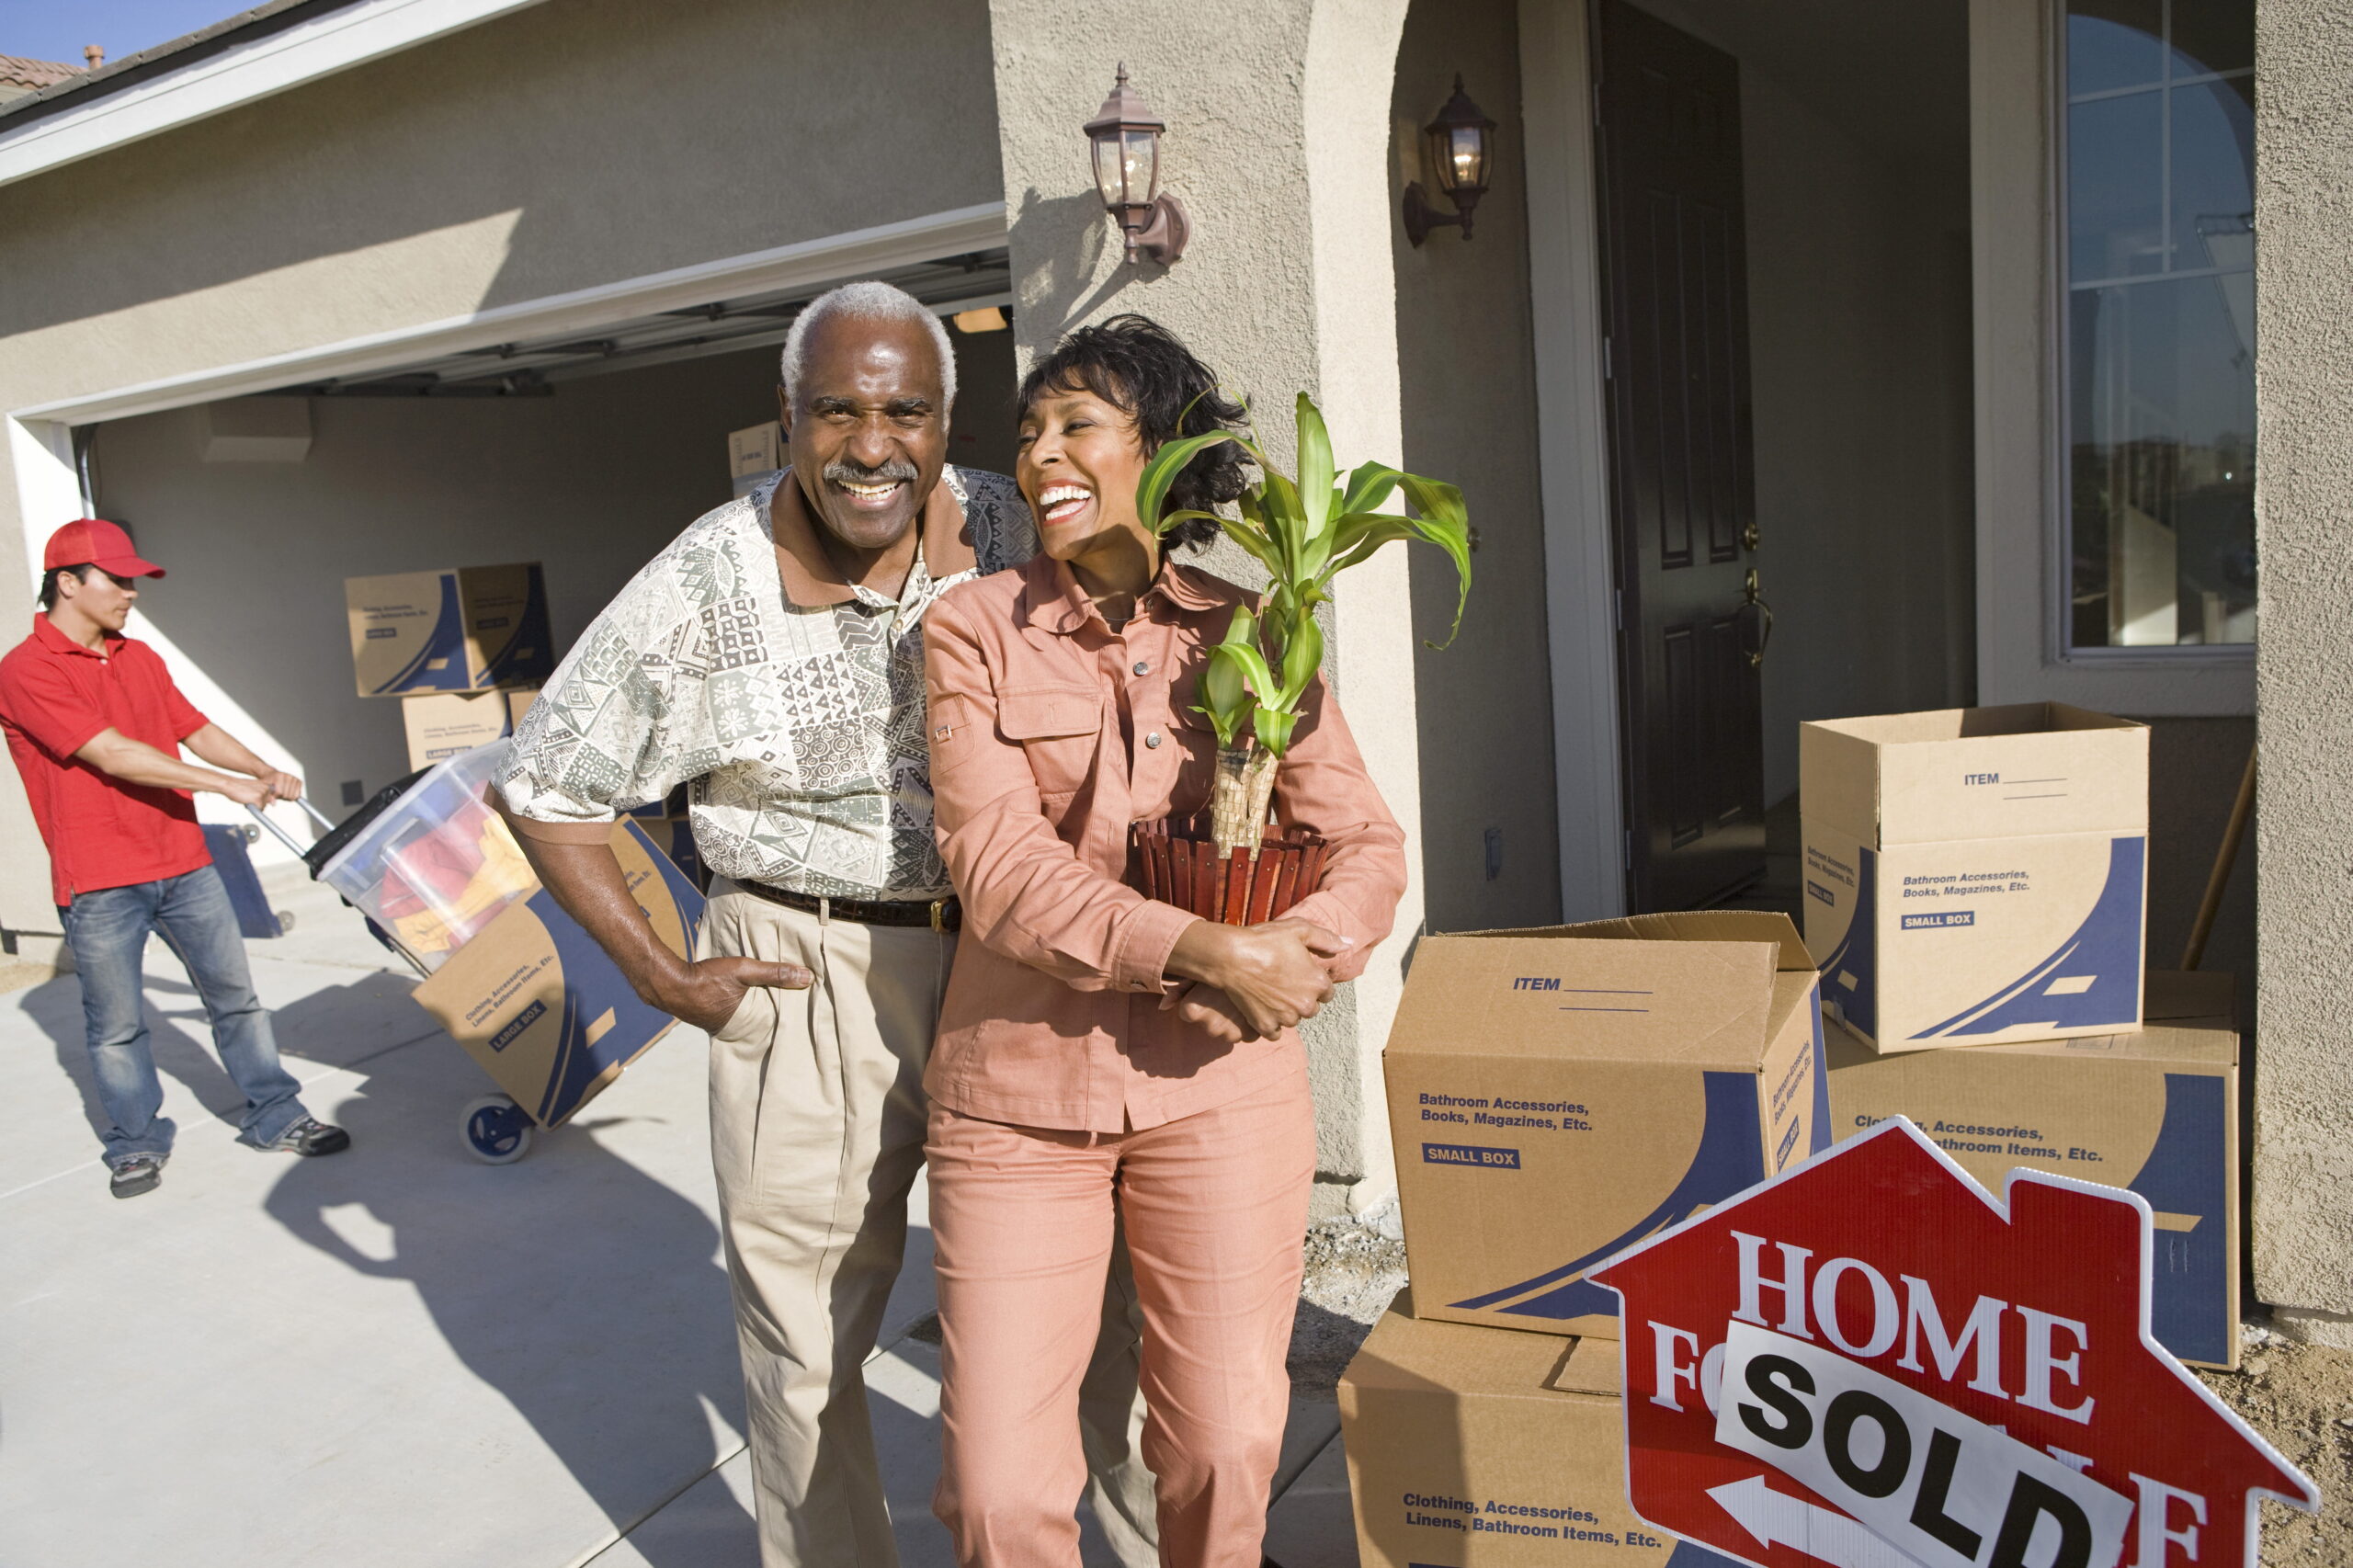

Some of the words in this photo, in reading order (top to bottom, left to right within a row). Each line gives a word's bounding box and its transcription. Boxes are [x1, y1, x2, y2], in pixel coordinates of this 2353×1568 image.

[1964, 773, 1999, 786] ITEM
[1904, 875, 1956, 885] Bathroom
[1960, 870, 2029, 882] Accessories,
[1904, 888, 1939, 897] Books,
[1944, 884, 2005, 896] Magazines,
[2009, 882, 2029, 892] Etc.
[1904, 916, 1943, 927] SMALL
[1946, 915, 1971, 925] BOX
[494, 982, 522, 1008] Bathroom
[1513, 977, 1561, 991] ITEM
[493, 1021, 523, 1048] LARGE
[520, 1006, 540, 1024] BOX
[1419, 1093, 1488, 1108] Bathroom
[1493, 1097, 1589, 1116] Accessories,
[1421, 1109, 1469, 1125] Books,
[1474, 1112, 1557, 1131] Magazines,
[1563, 1118, 1593, 1131] Etc.
[1933, 1120, 2043, 1142] Accessories,
[1428, 1148, 1478, 1163] SMALL
[1482, 1152, 1515, 1165] BOX
[2007, 1142, 2062, 1160] Items,
[2068, 1147, 2103, 1162] Etc.
[1731, 1230, 2095, 1425] HOME
[1737, 1354, 2092, 1568] SOLD
[1403, 1493, 1480, 1515] Clothing,
[1484, 1500, 1599, 1525] Accessories,
[1406, 1512, 1467, 1531] Linens,
[1472, 1517, 1558, 1538] Bathroom
[1563, 1527, 1620, 1546] Items,
[1625, 1531, 1662, 1548] Etc.
